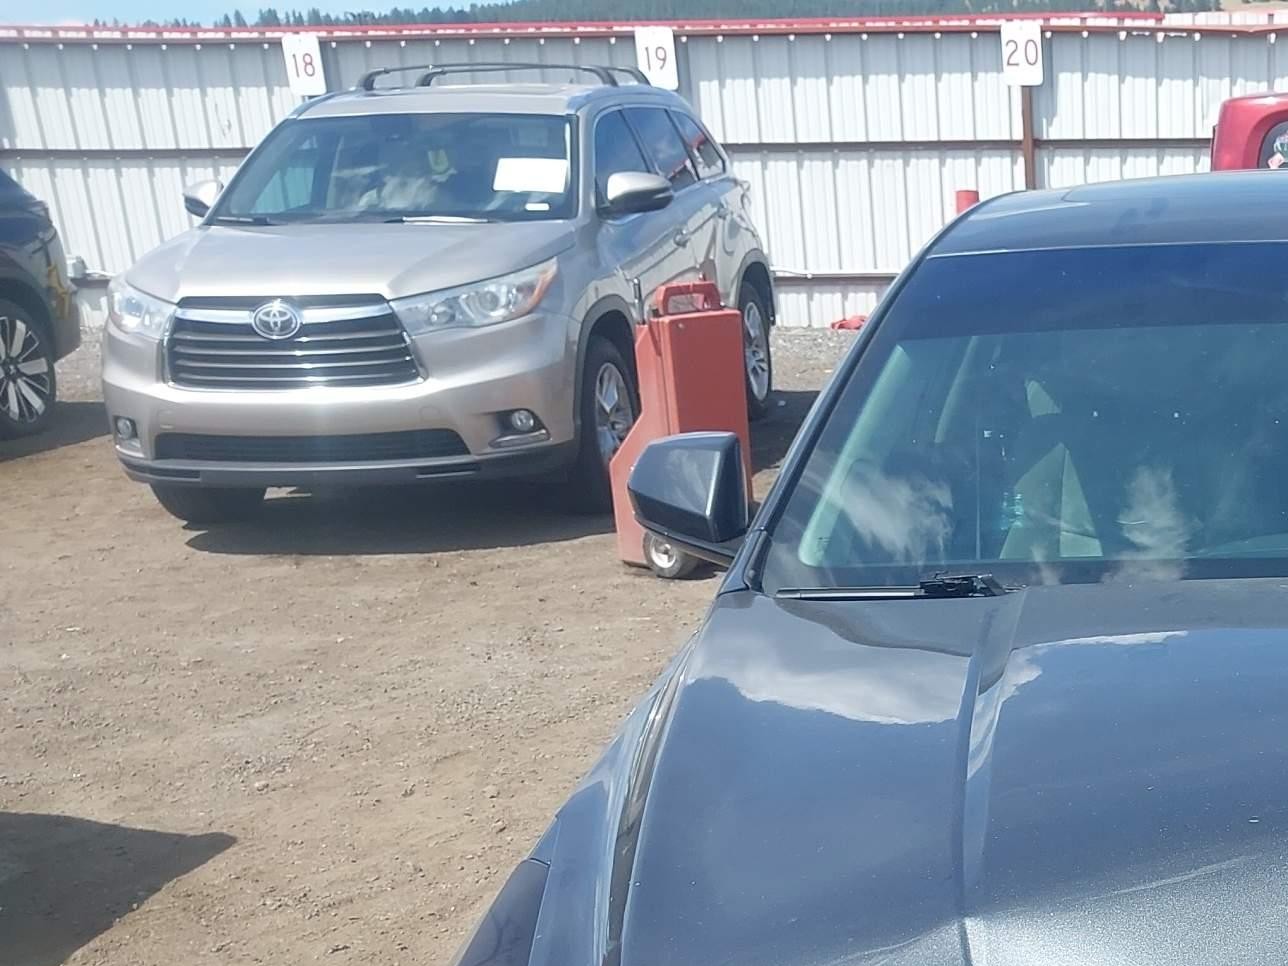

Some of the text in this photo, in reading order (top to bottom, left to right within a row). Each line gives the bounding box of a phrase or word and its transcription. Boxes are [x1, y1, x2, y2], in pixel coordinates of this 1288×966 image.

[645, 46, 667, 70] 19
[1006, 39, 1038, 66] 20
[292, 53, 315, 77] 18
